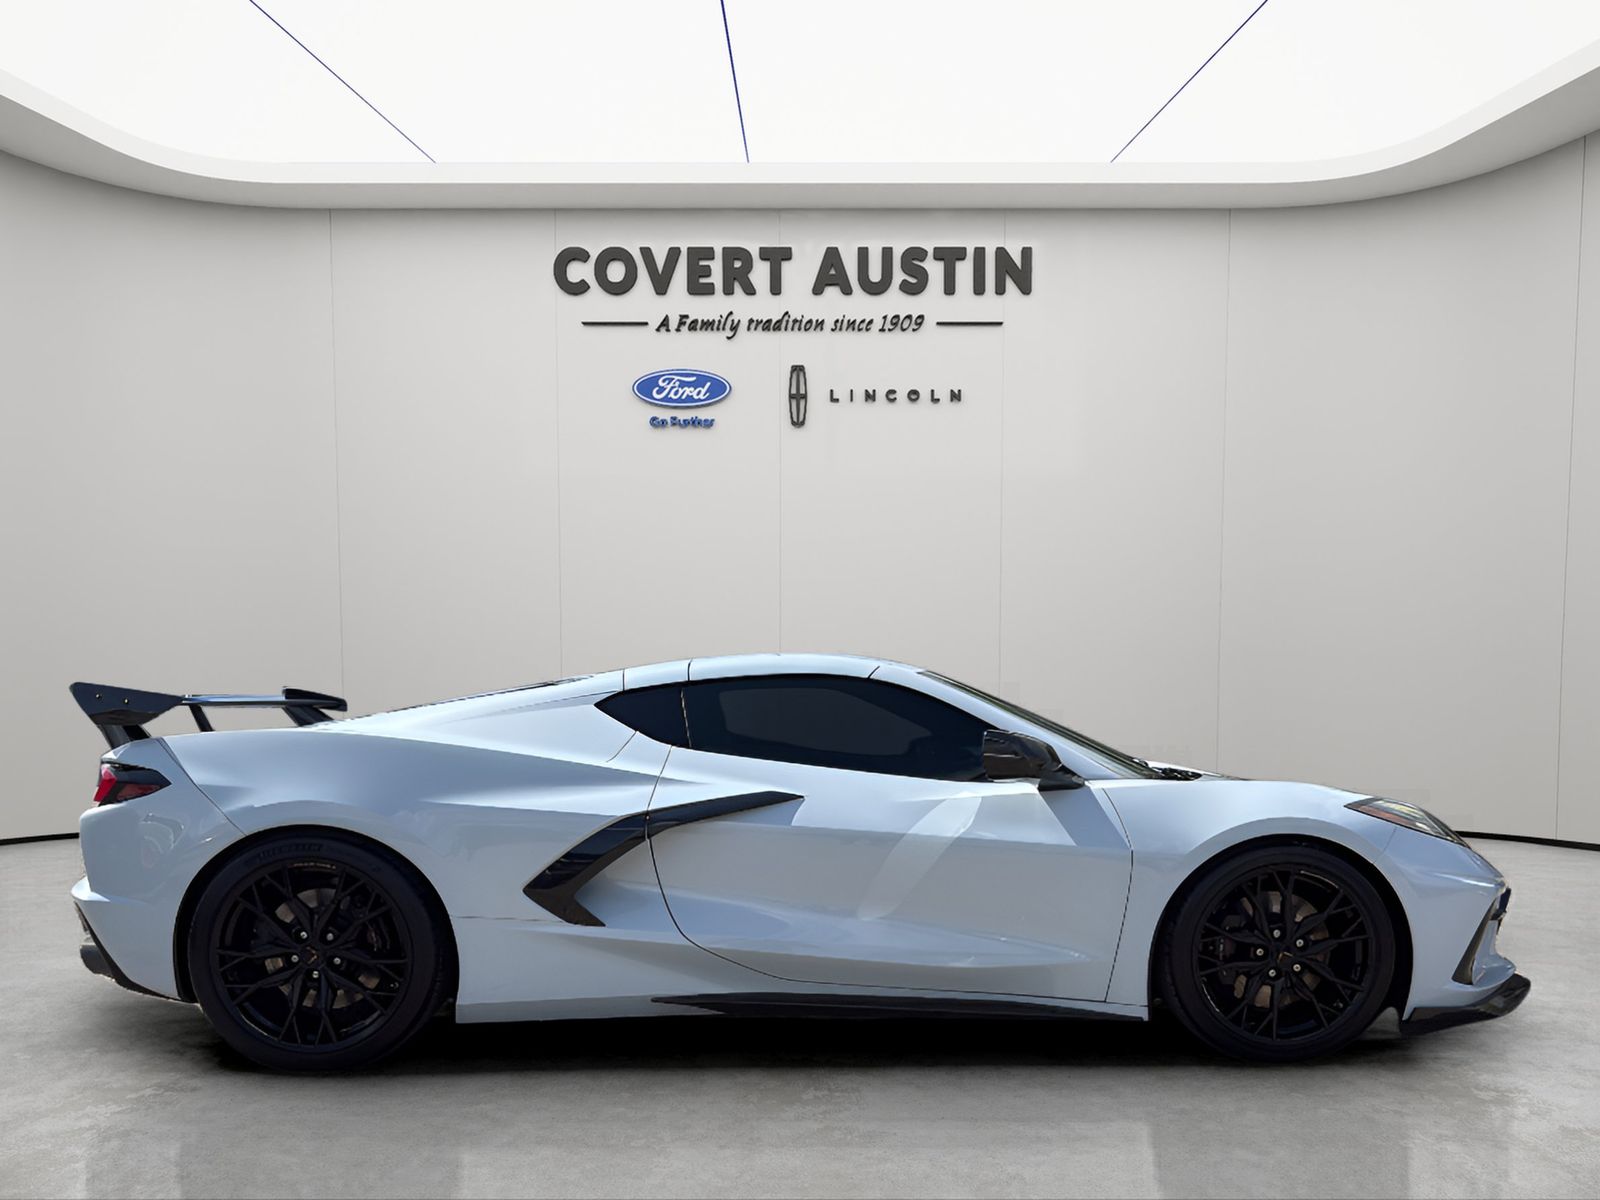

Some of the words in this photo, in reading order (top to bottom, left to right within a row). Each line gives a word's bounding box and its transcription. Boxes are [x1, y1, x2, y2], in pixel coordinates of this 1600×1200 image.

[554, 246, 793, 297] COVERT
[812, 246, 1034, 297] AUSTIN
[655, 314, 672, 333] A
[675, 311, 741, 340] Family
[747, 311, 826, 333] tradition
[831, 315, 874, 333] since
[879, 313, 925, 333] 1909
[652, 375, 711, 400] Ford
[829, 389, 963, 404] LINCOLN
